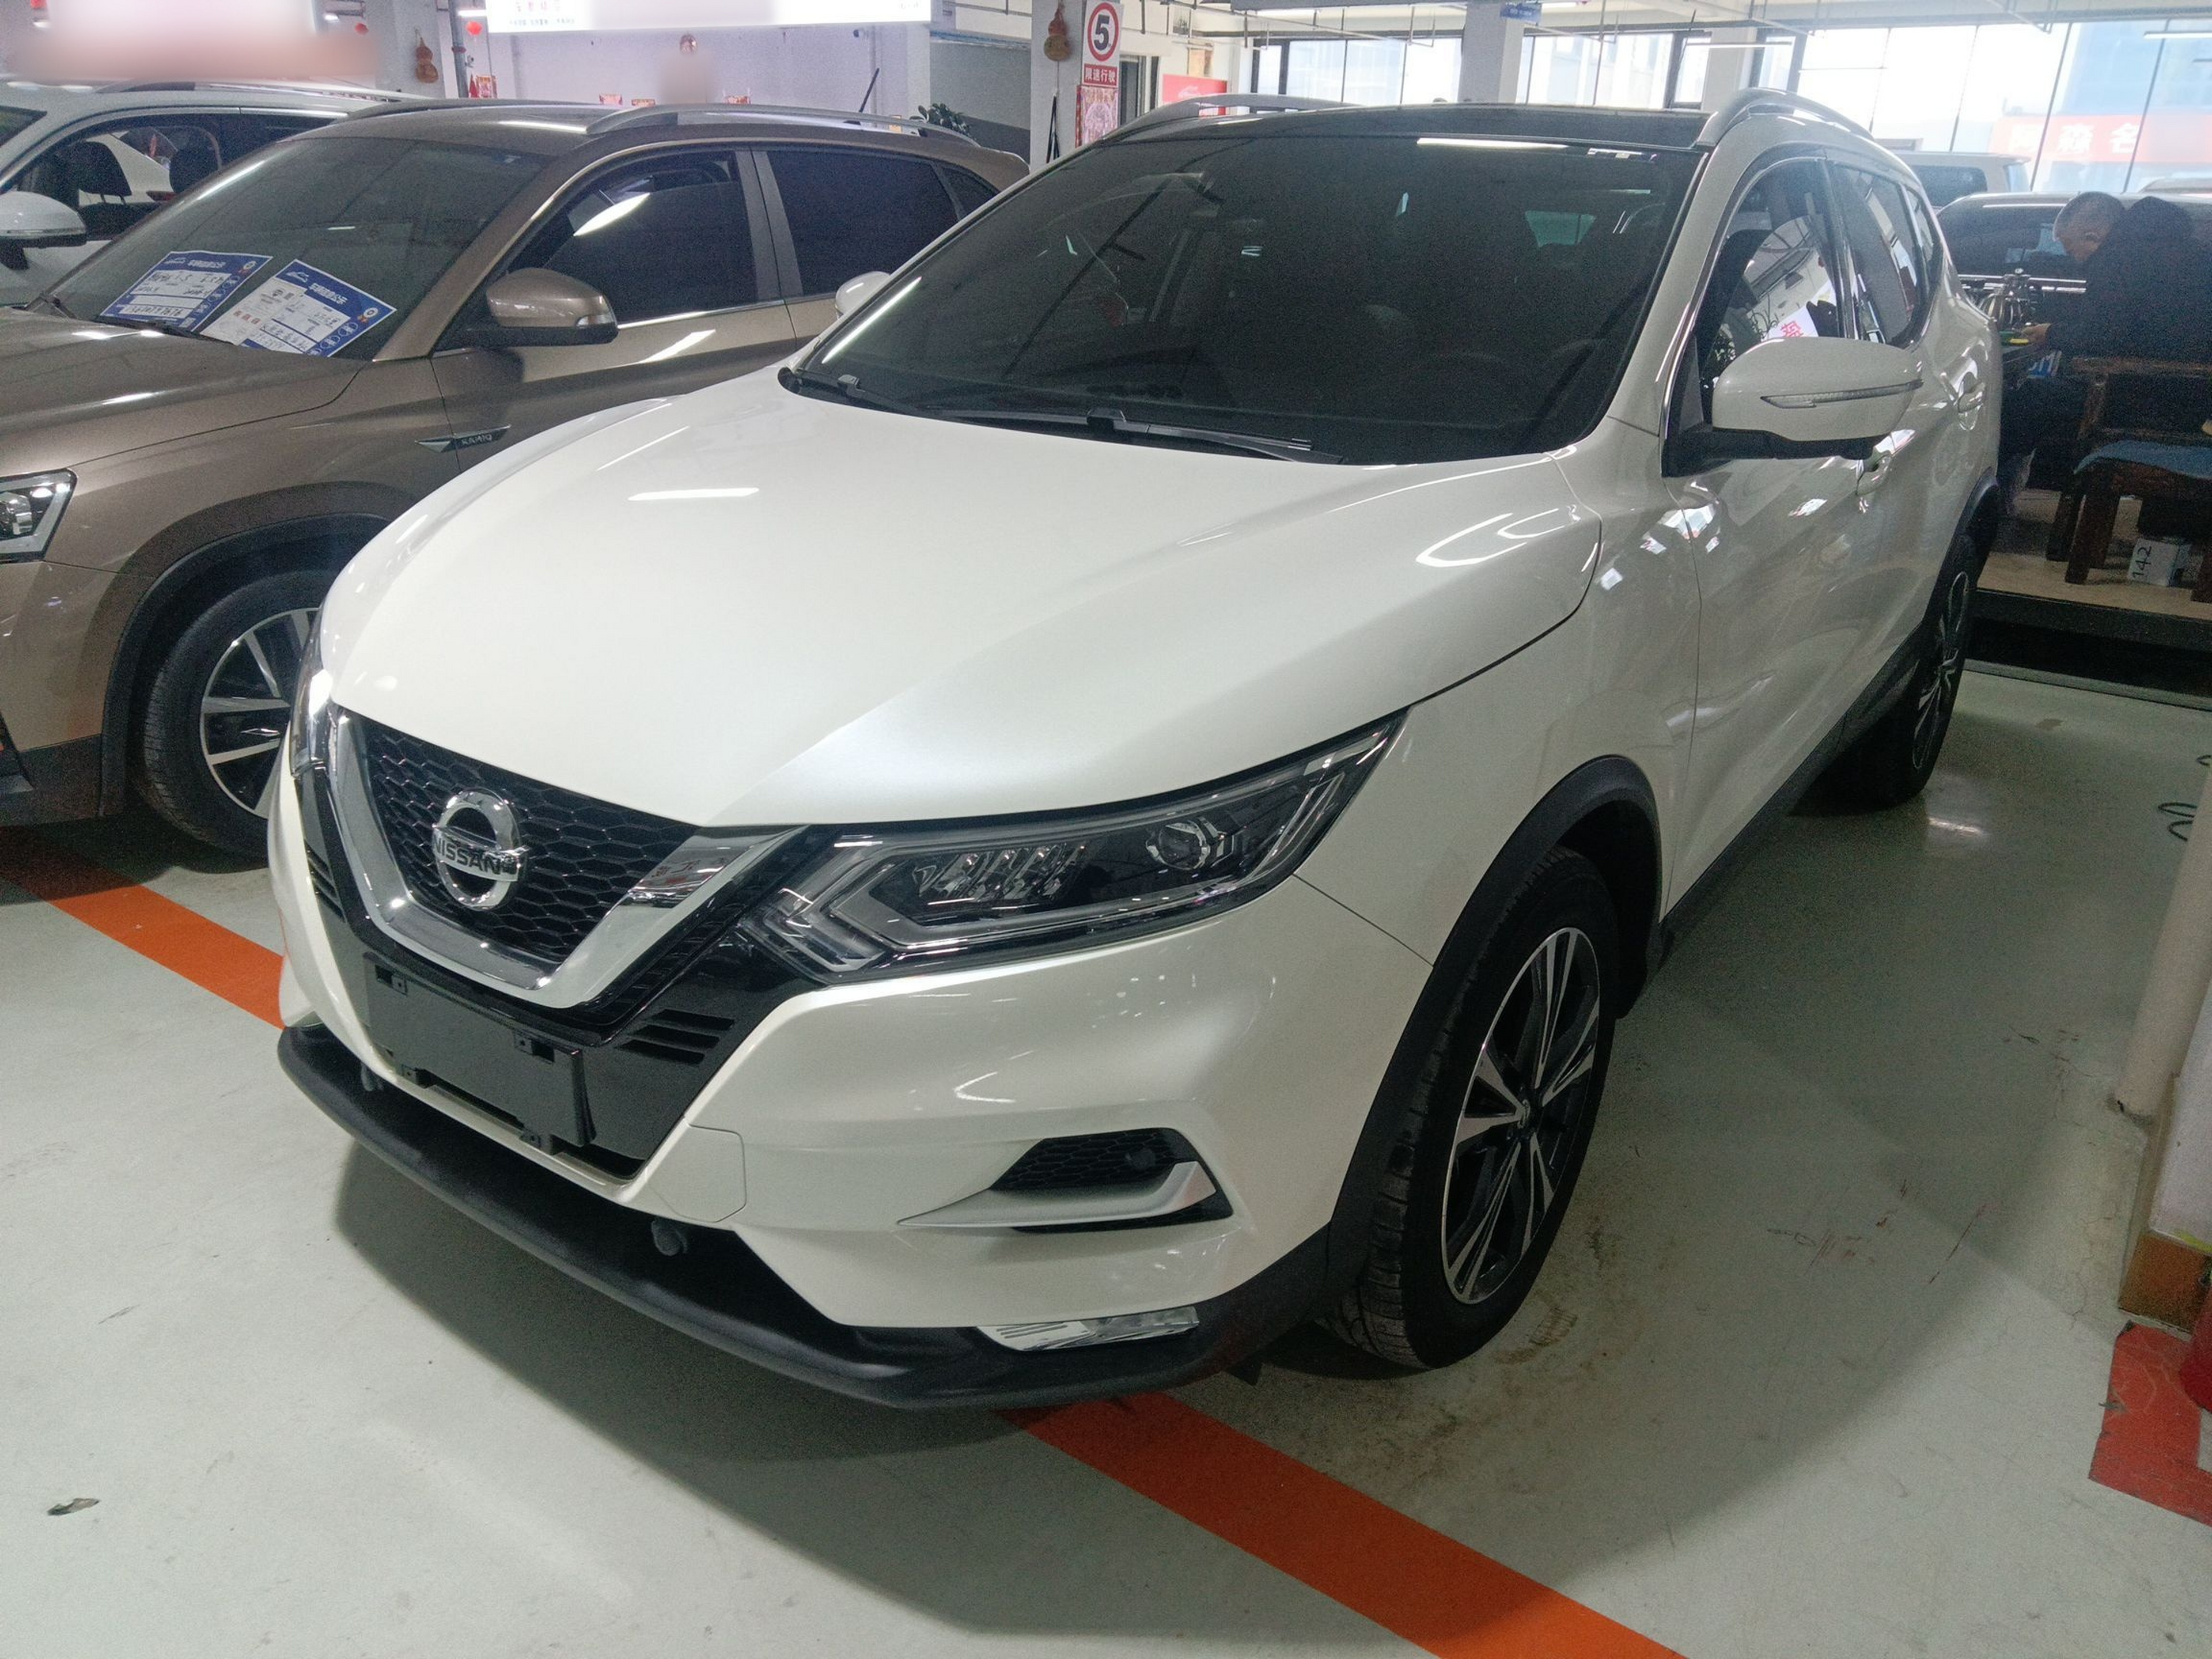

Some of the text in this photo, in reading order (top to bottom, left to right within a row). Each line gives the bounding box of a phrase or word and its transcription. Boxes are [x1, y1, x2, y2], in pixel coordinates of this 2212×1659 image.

[1094, 14, 1109, 50] 5
[1085, 67, 1116, 82] 限速行驶
[434, 837, 503, 875] NISSAN
